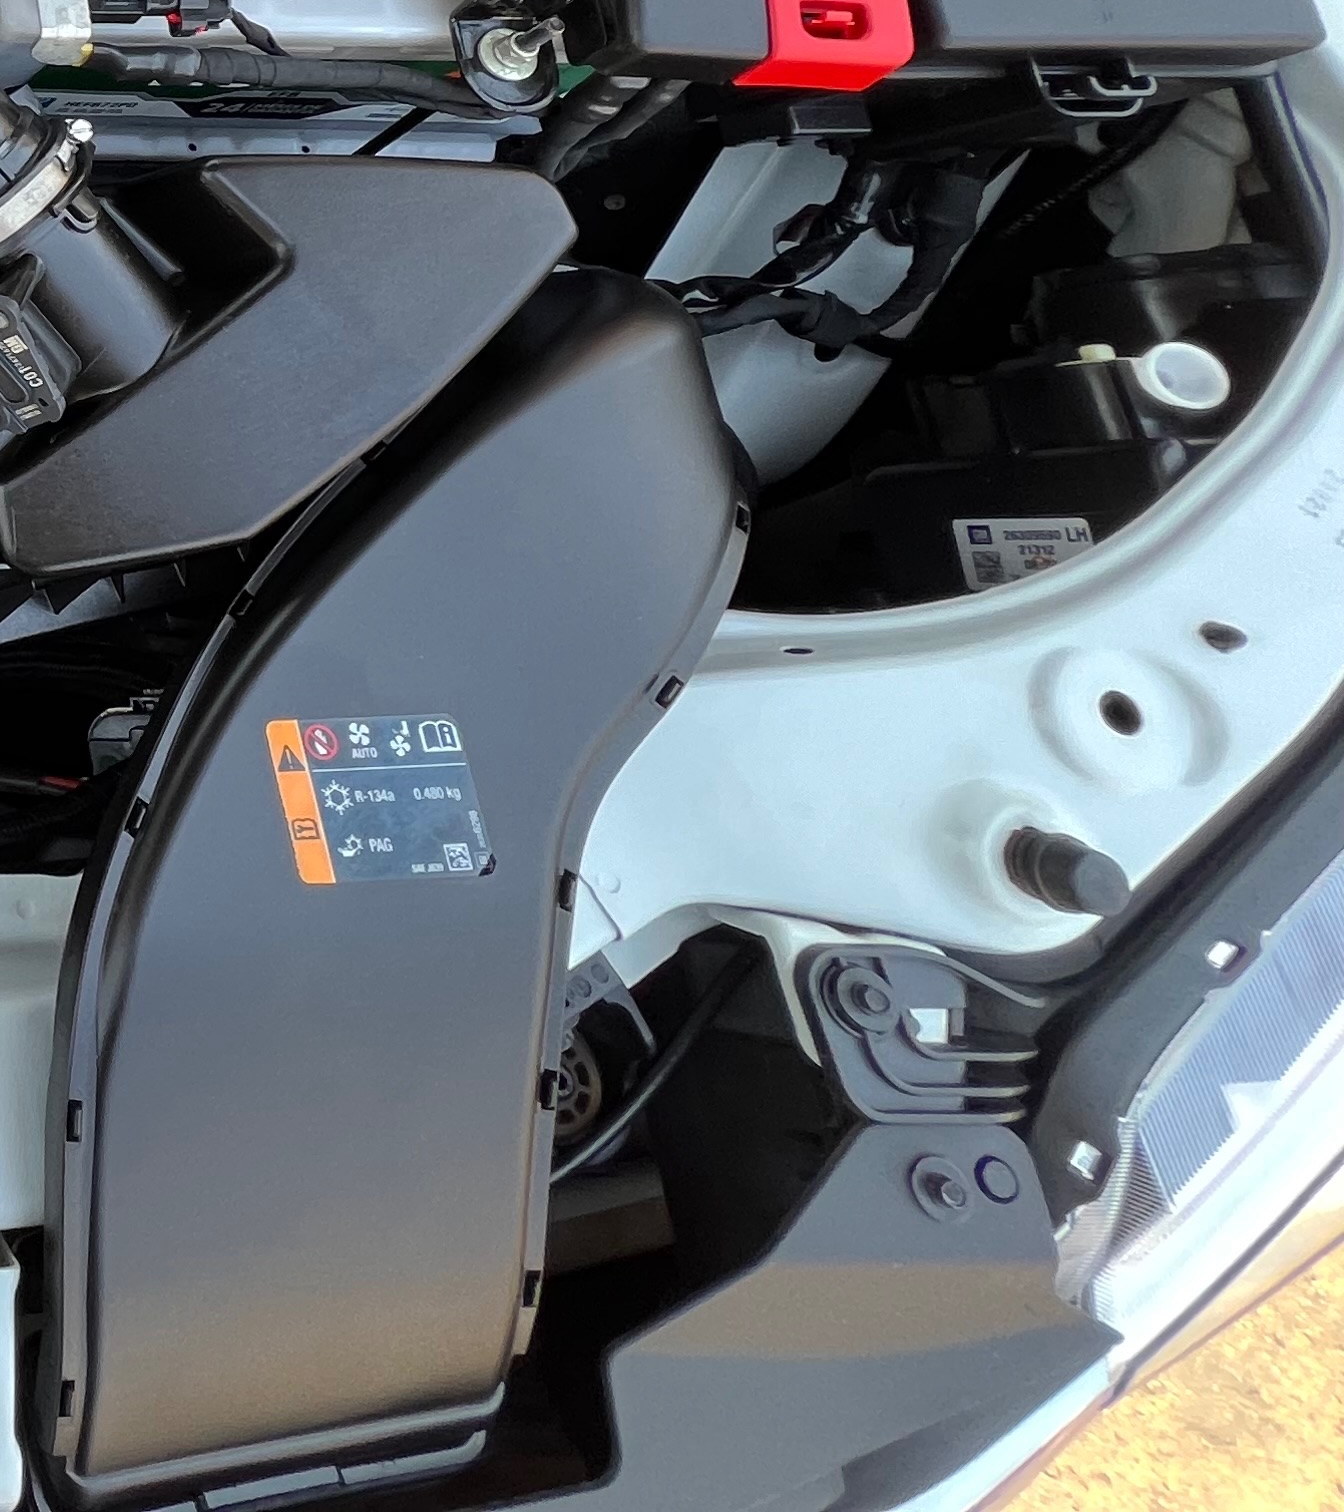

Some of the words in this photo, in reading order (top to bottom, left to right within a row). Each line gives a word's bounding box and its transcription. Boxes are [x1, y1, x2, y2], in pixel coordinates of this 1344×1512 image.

[1065, 526, 1089, 543] LH
[352, 747, 379, 759] AUTO
[354, 789, 396, 803] R-134a
[445, 786, 463, 802] kg
[369, 838, 394, 853] PAG
